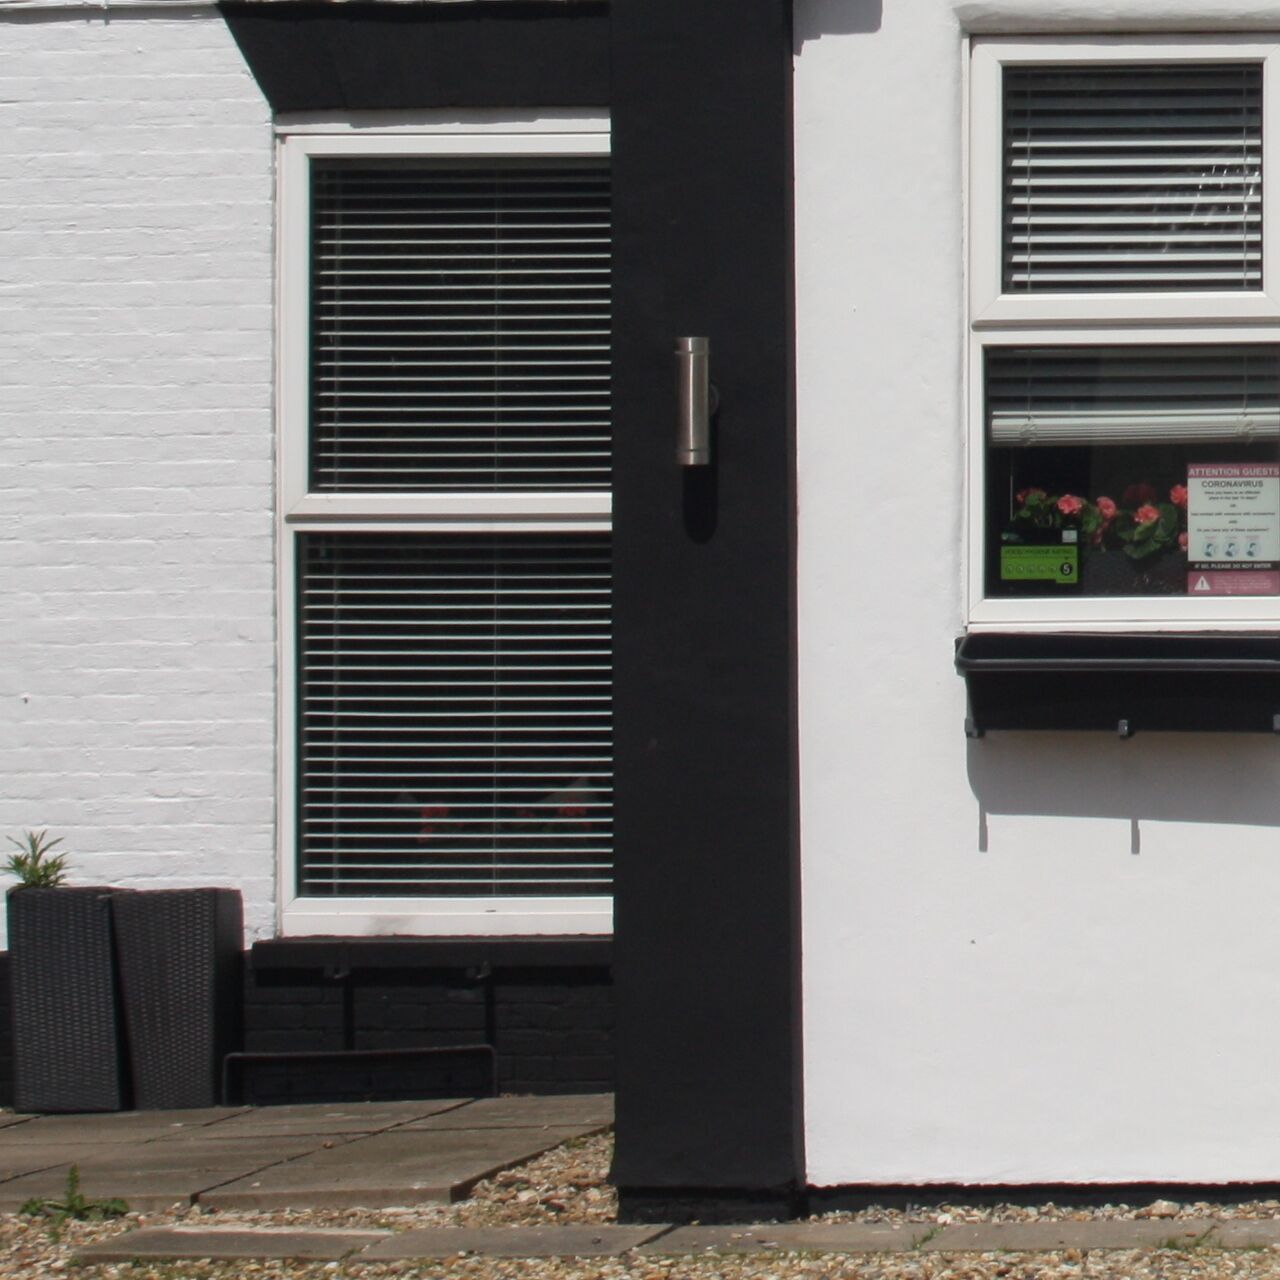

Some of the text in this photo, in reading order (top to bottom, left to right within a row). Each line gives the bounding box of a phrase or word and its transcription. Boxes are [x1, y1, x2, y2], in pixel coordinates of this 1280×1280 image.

[1188, 467, 1280, 476] ATTENTION GUESTS
[1201, 480, 1264, 488] CORONAVIRUS
[1063, 564, 1070, 574] 5
